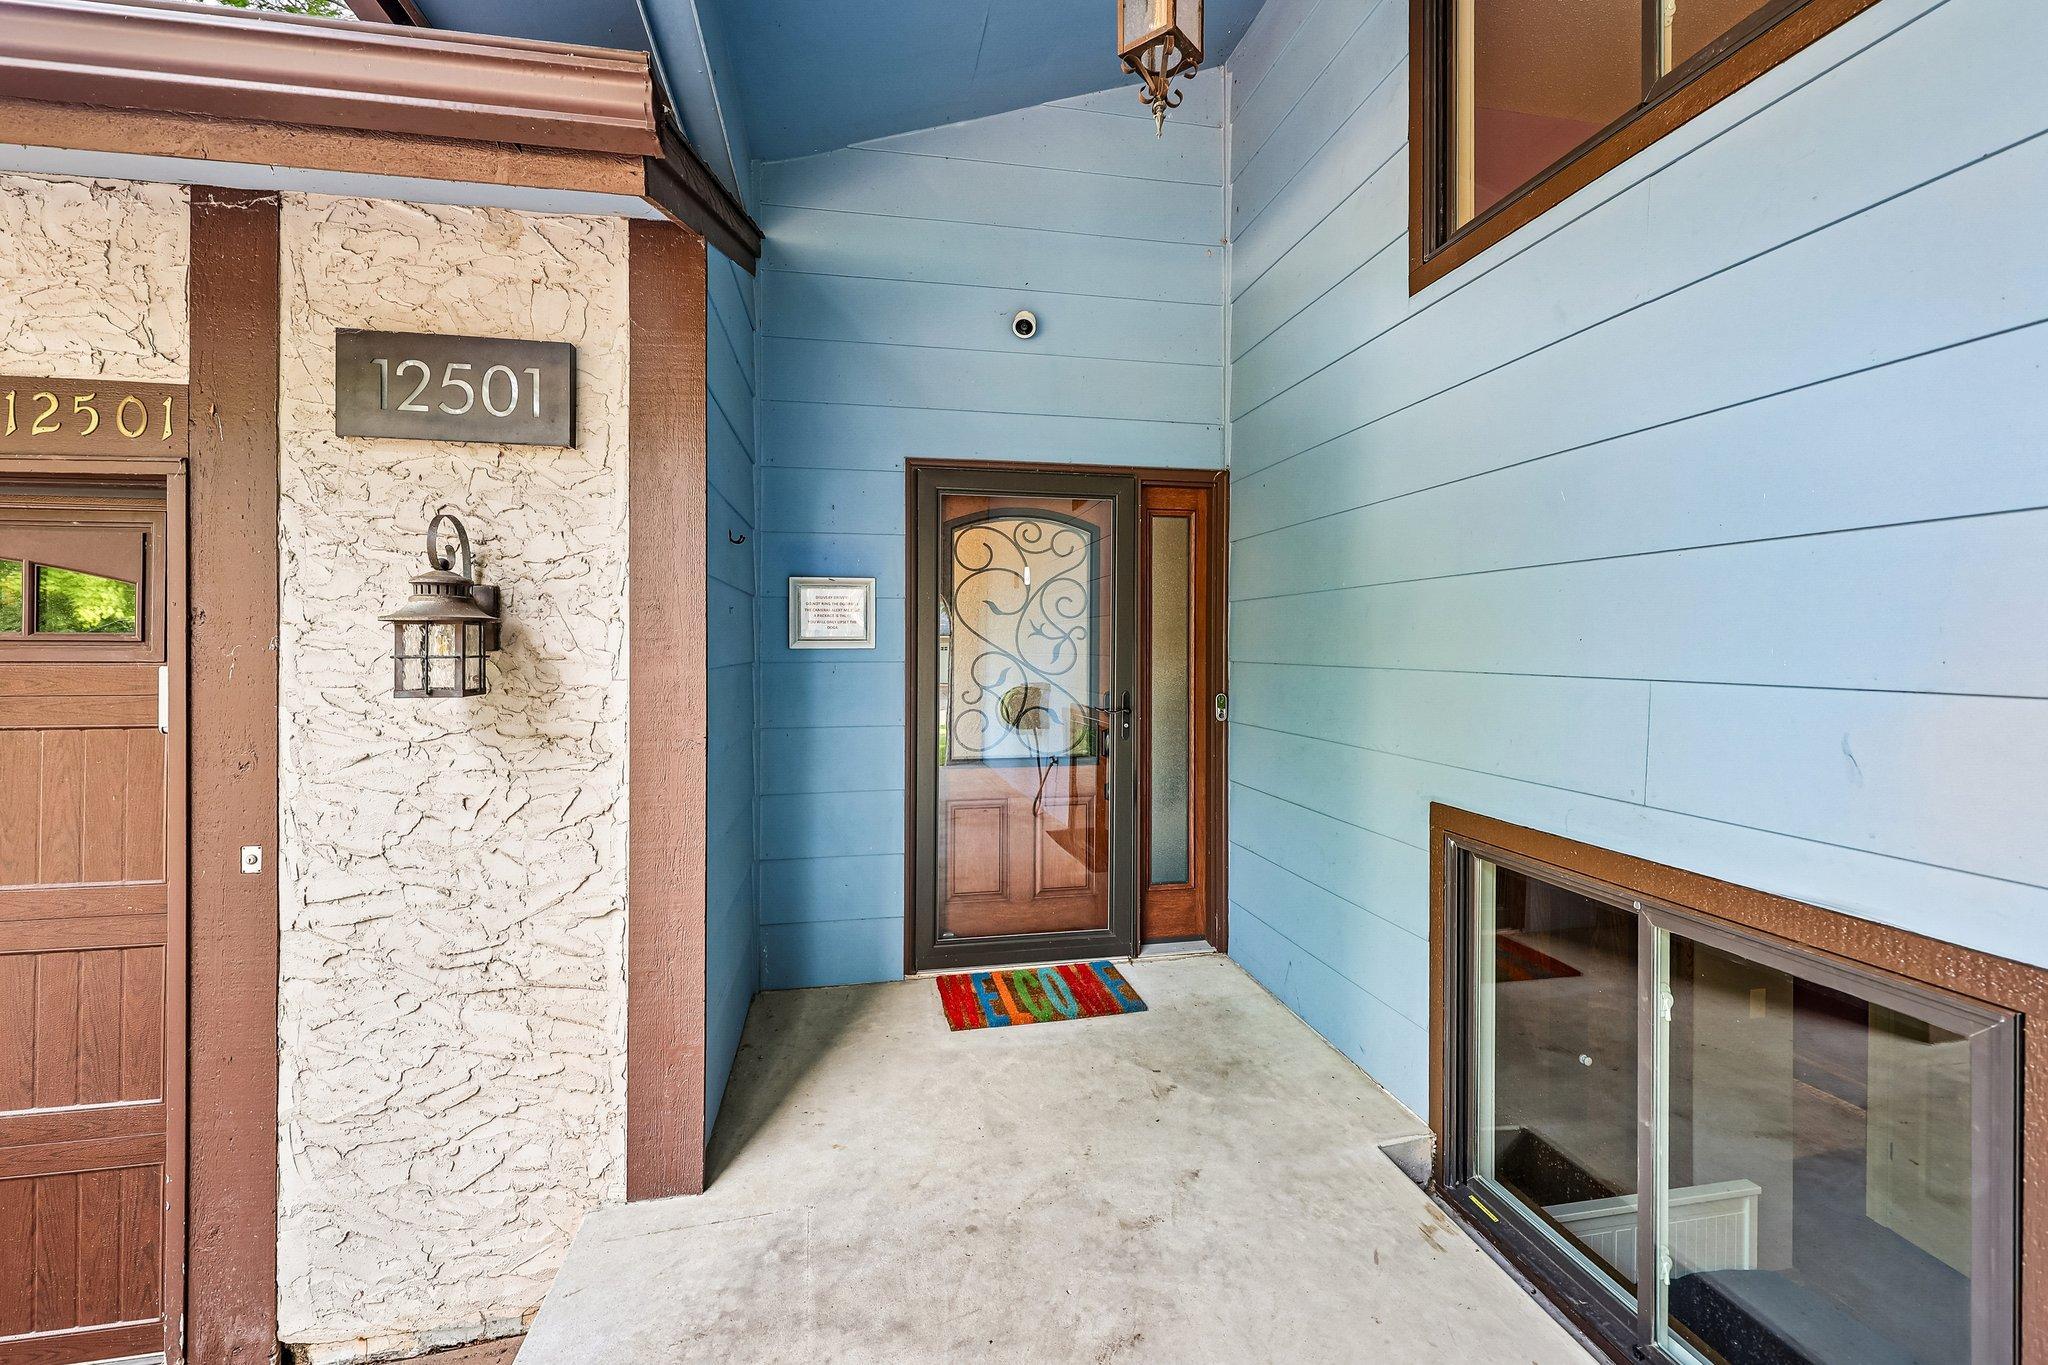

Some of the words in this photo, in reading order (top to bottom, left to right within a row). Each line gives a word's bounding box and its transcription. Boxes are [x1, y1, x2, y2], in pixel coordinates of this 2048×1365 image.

[5, 389, 174, 441] 12501
[372, 357, 542, 419] 12501
[936, 960, 1149, 1031] WELCOME
